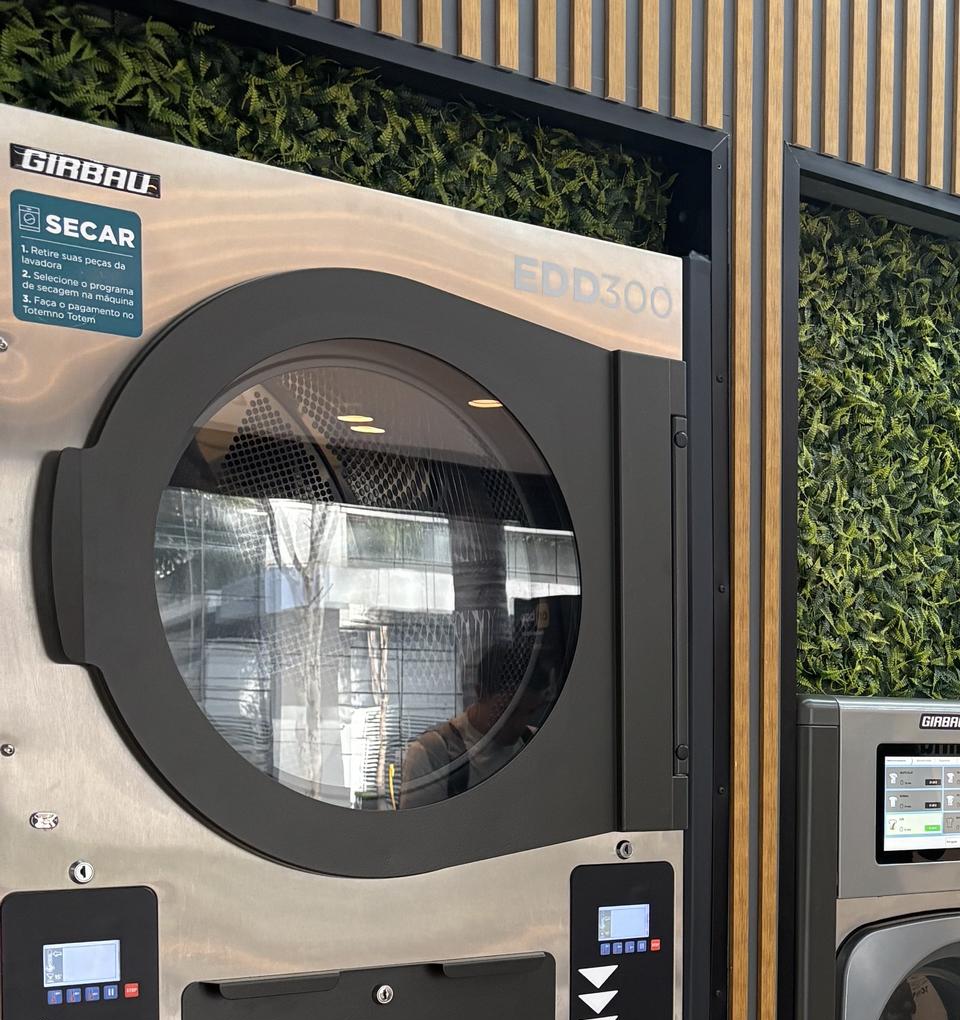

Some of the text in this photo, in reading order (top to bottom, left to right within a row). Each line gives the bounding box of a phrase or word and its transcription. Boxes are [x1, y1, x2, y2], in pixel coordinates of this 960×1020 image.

[22, 148, 151, 194] GIRBAU
[45, 214, 135, 248] SECAR
[21, 244, 126, 271] 1. Retire suas peças da
[21, 256, 62, 270] lavadora
[22, 270, 31, 279] 2.
[33, 272, 79, 287] Selecione
[90, 282, 134, 296] programa
[22, 281, 134, 307] de secagem na máquina
[514, 255, 673, 319] EDD300
[22, 294, 134, 320] 3. Faça o pagamento no
[22, 305, 96, 324] Totemno Totem
